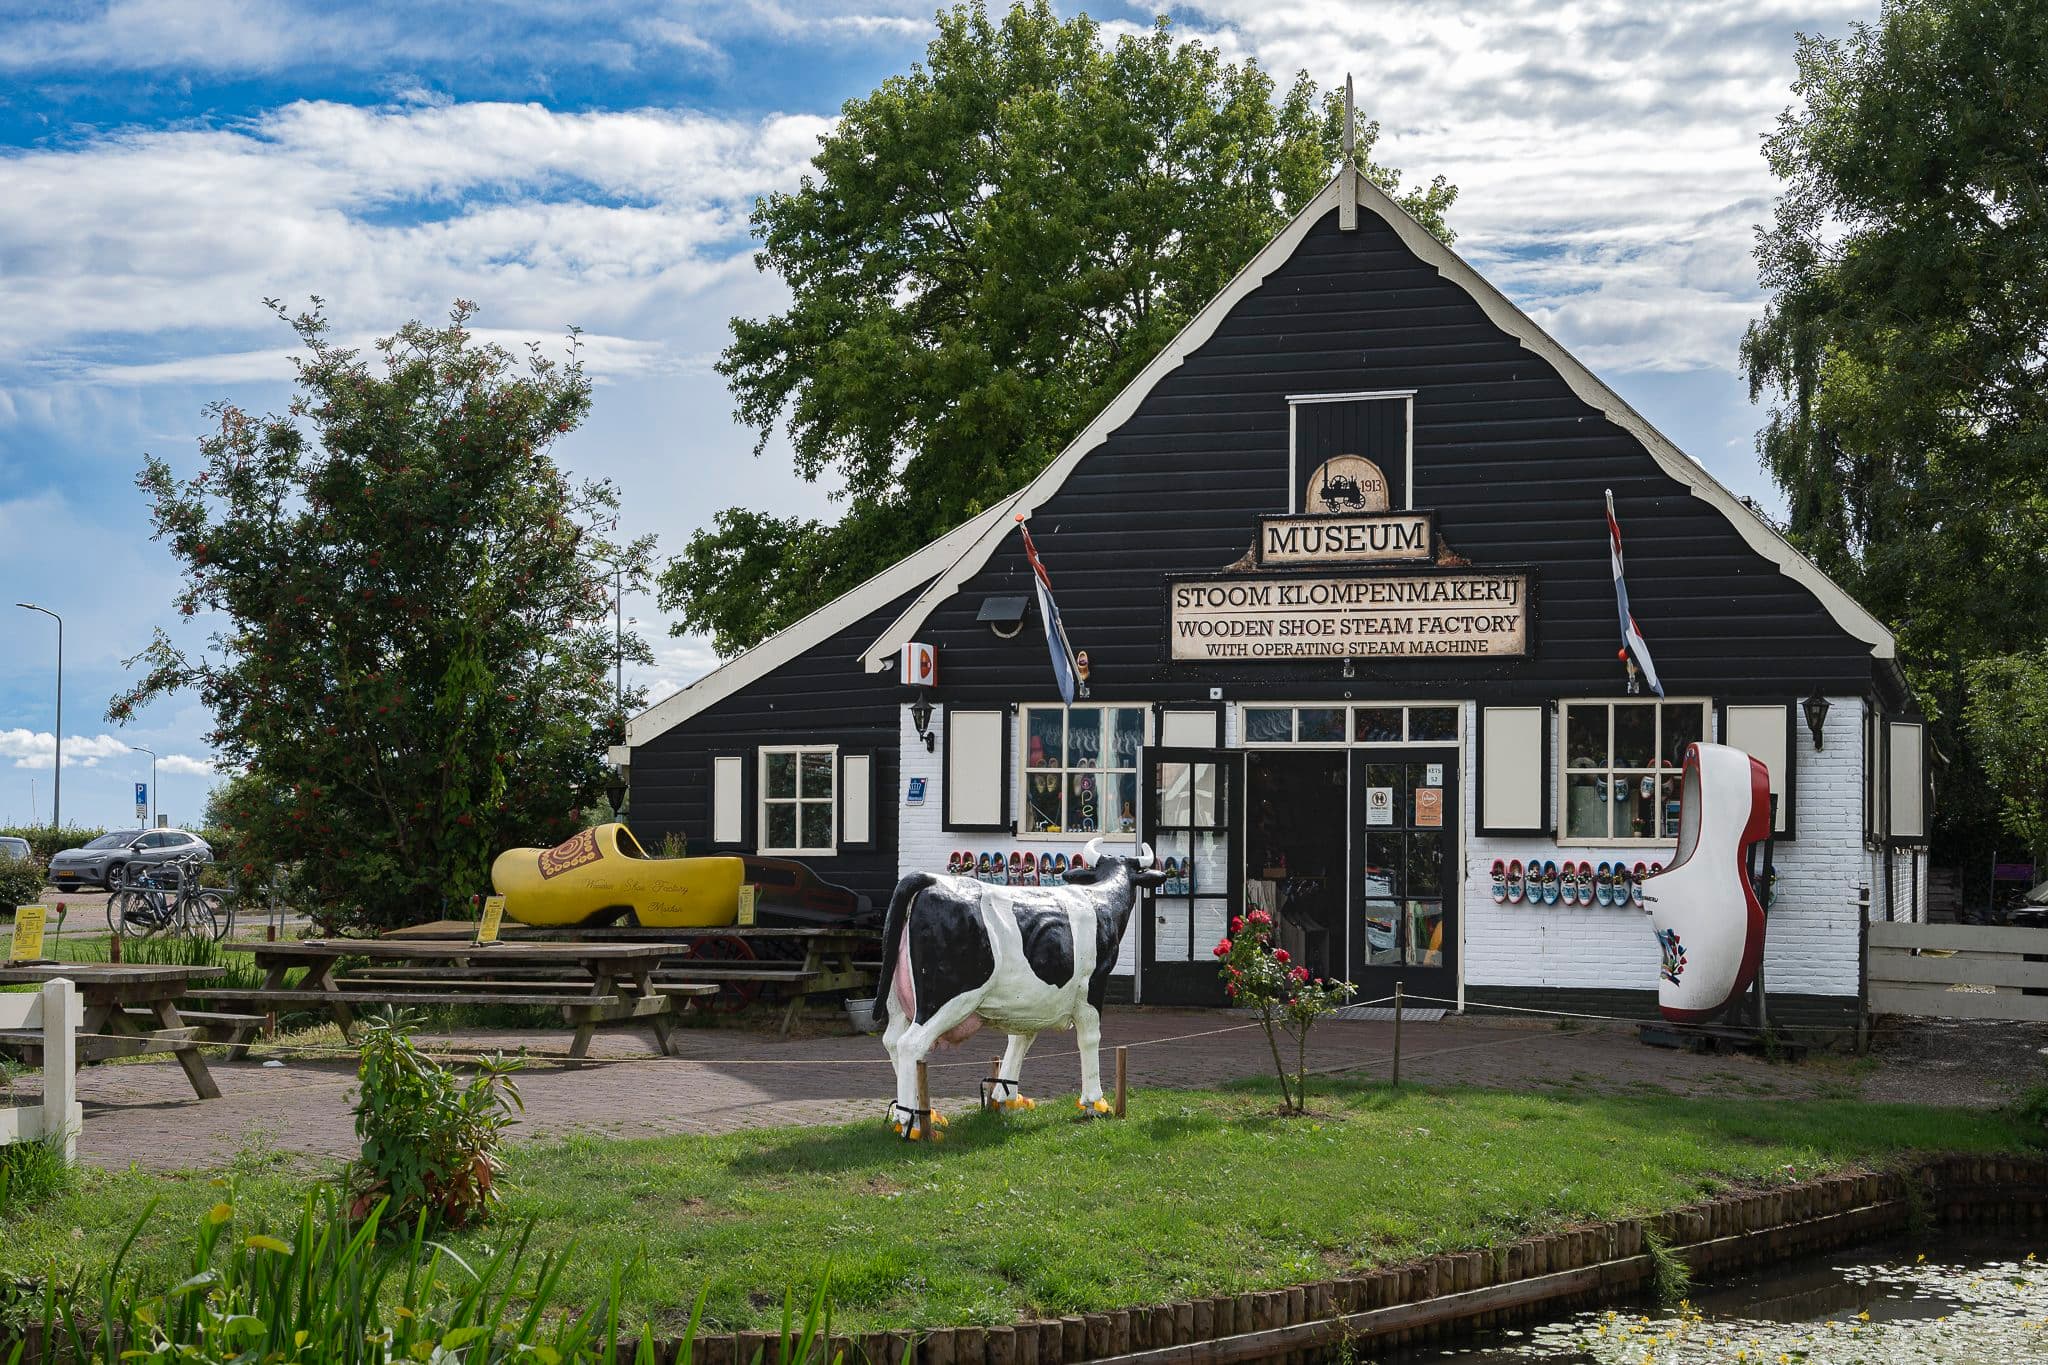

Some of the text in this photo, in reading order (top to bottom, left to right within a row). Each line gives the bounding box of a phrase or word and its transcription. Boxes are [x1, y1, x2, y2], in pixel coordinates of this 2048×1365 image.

[1360, 479, 1382, 493] 1913
[1267, 522, 1425, 554] MUSEUM
[1176, 579, 1520, 609] STOOM KLOMPENMAKERIJ
[1178, 615, 1520, 638] WOODEN SHOE STEAM FACTORY
[1206, 639, 1489, 657] WITH OPERATING STEAM MACHINE
